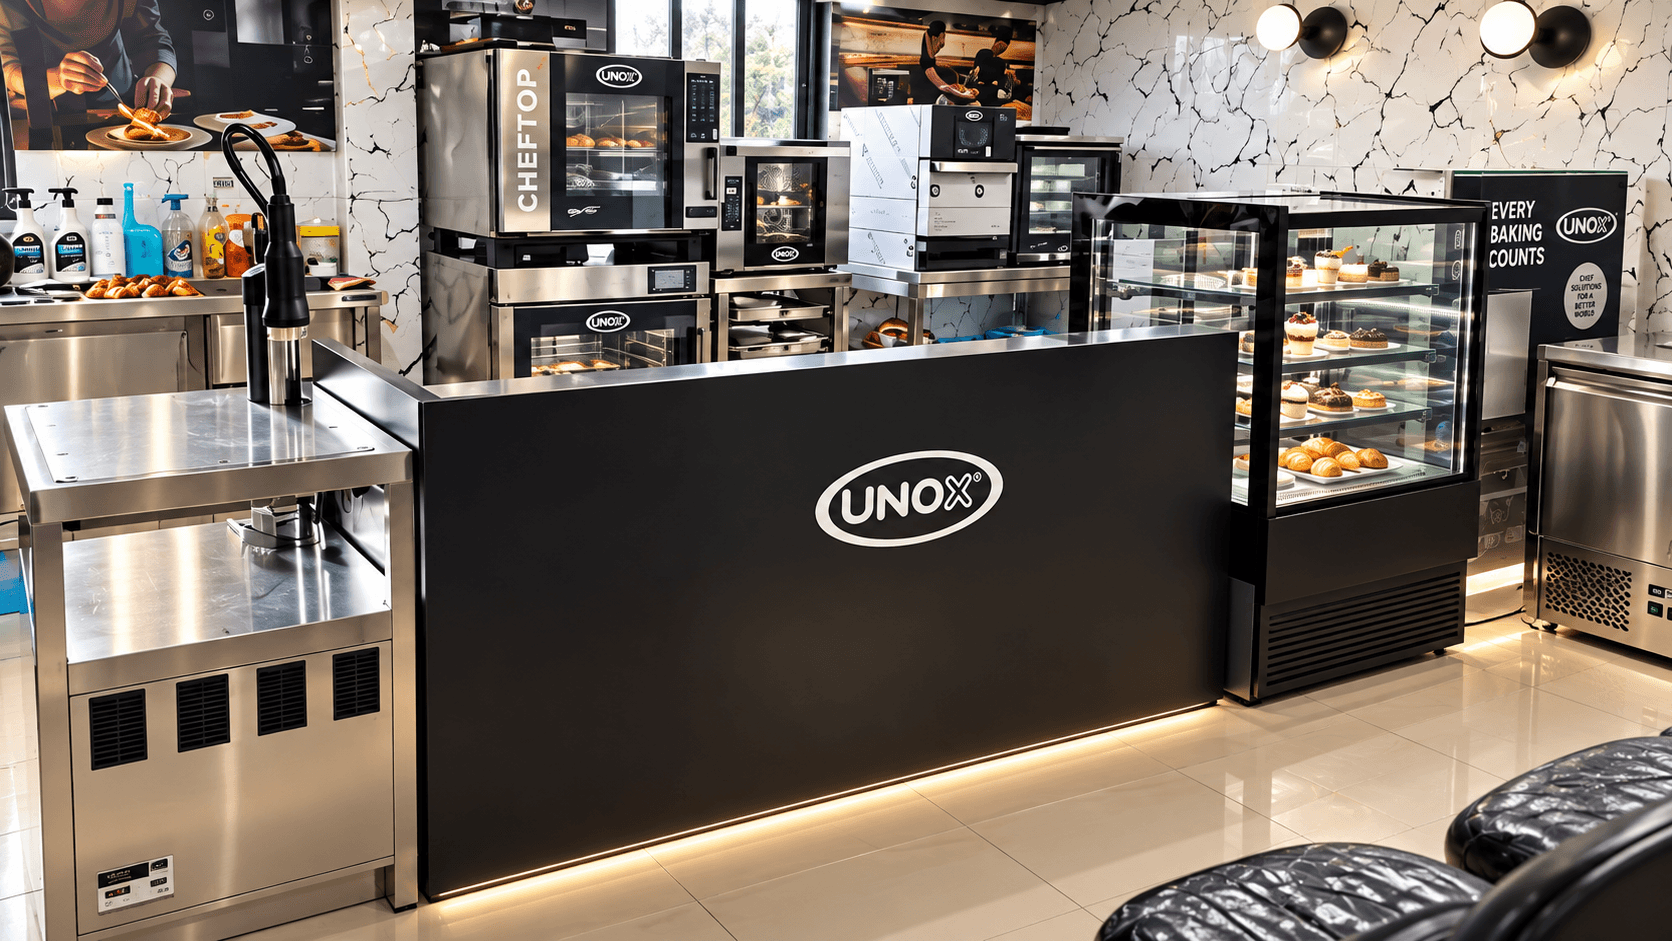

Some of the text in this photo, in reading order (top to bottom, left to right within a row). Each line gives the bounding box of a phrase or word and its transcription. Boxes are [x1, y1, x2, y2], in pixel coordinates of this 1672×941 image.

[516, 69, 538, 213] CHEFTOP
[1491, 200, 1536, 220] EVERY
[1490, 223, 1543, 243] BAKING
[1563, 216, 1607, 235] UNOX
[1489, 247, 1545, 268] COUNTS
[841, 473, 973, 525] UNOX
